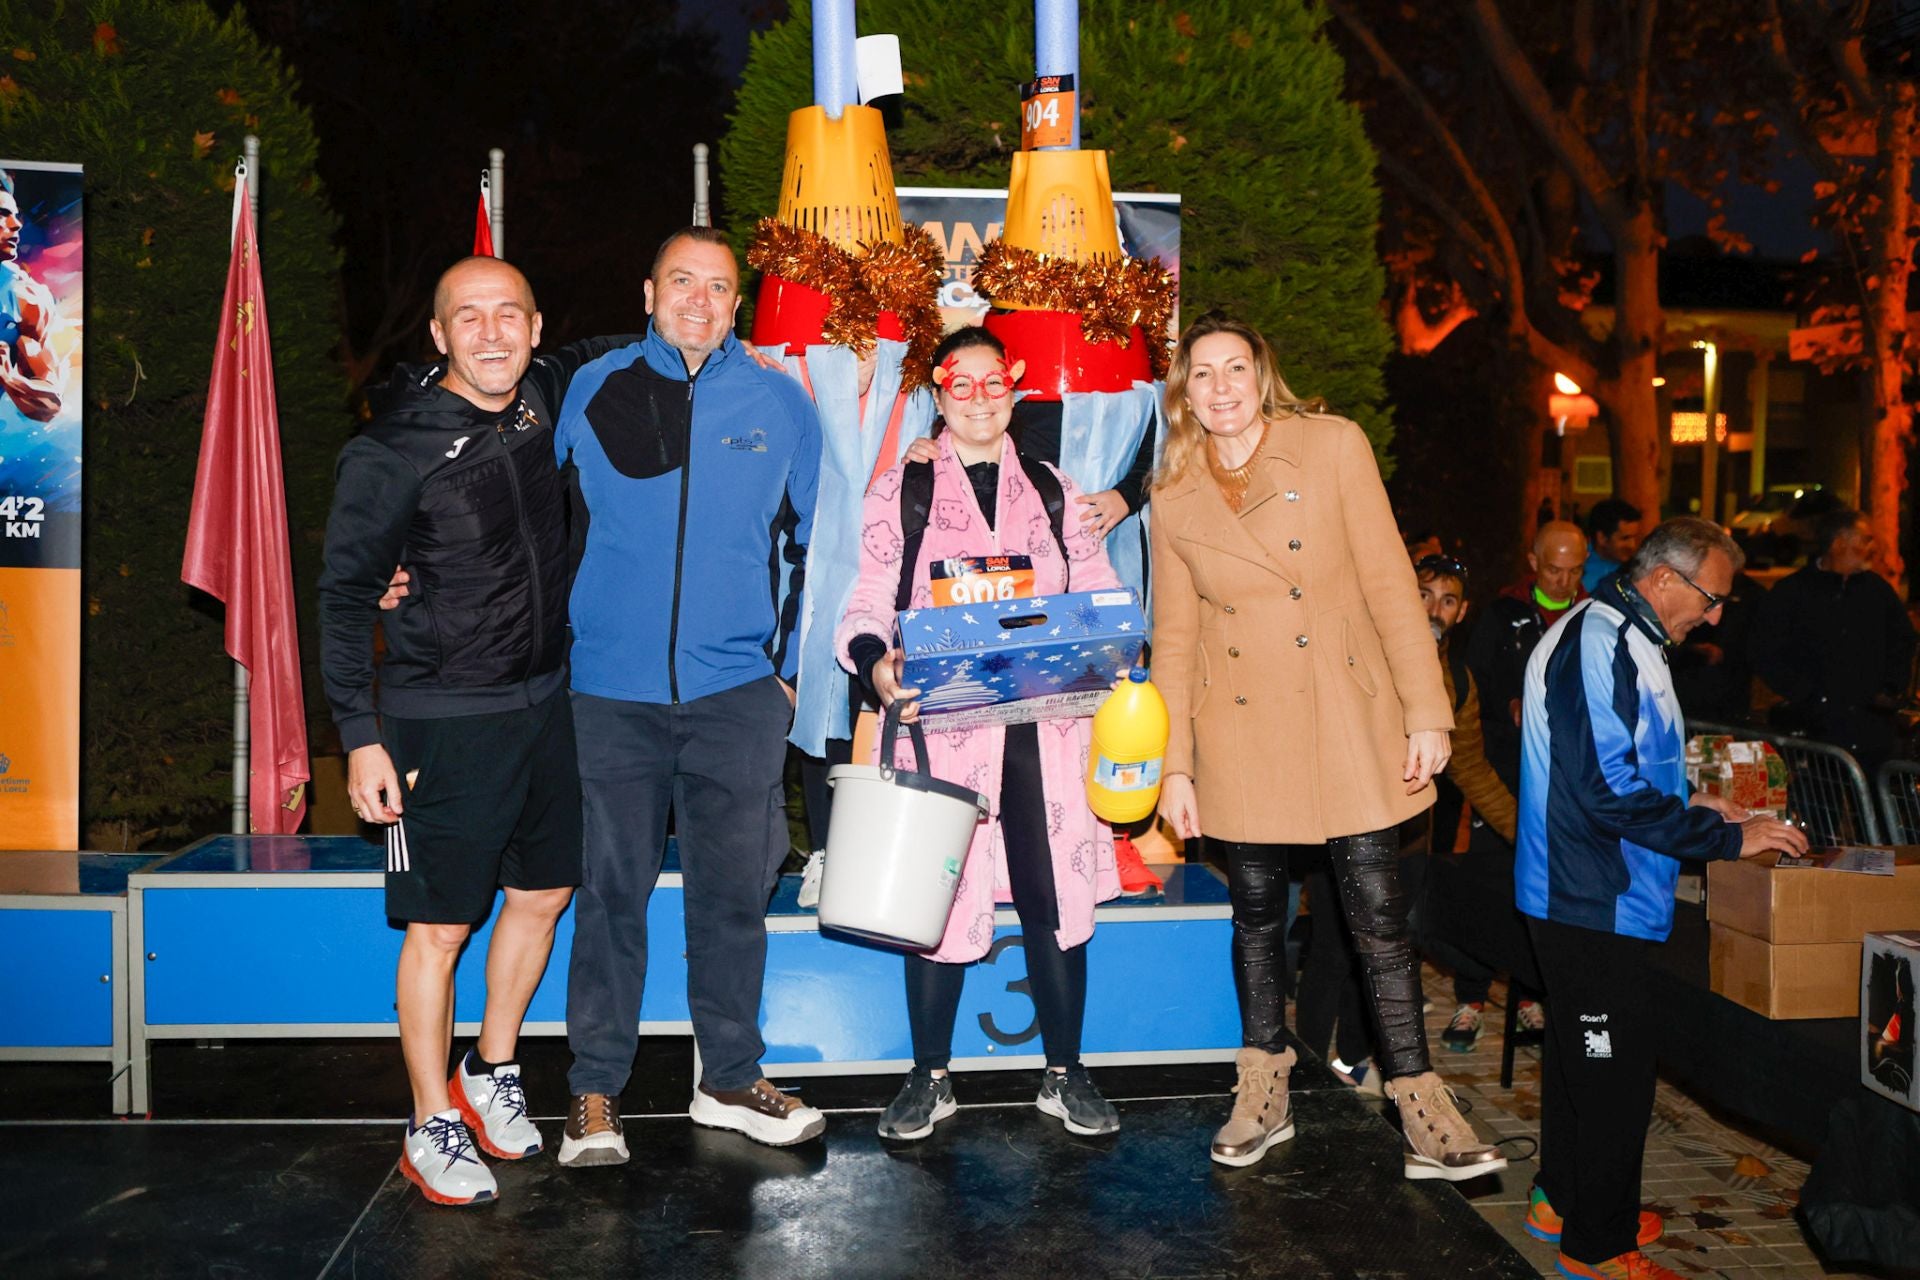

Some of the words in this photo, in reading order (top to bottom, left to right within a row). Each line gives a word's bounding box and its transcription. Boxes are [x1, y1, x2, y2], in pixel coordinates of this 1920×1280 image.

[1026, 98, 1060, 133] 904
[6, 522, 40, 538] KM
[985, 557, 1009, 566] SAN
[950, 576, 1015, 604] 906
[977, 935, 1042, 1046] 3
